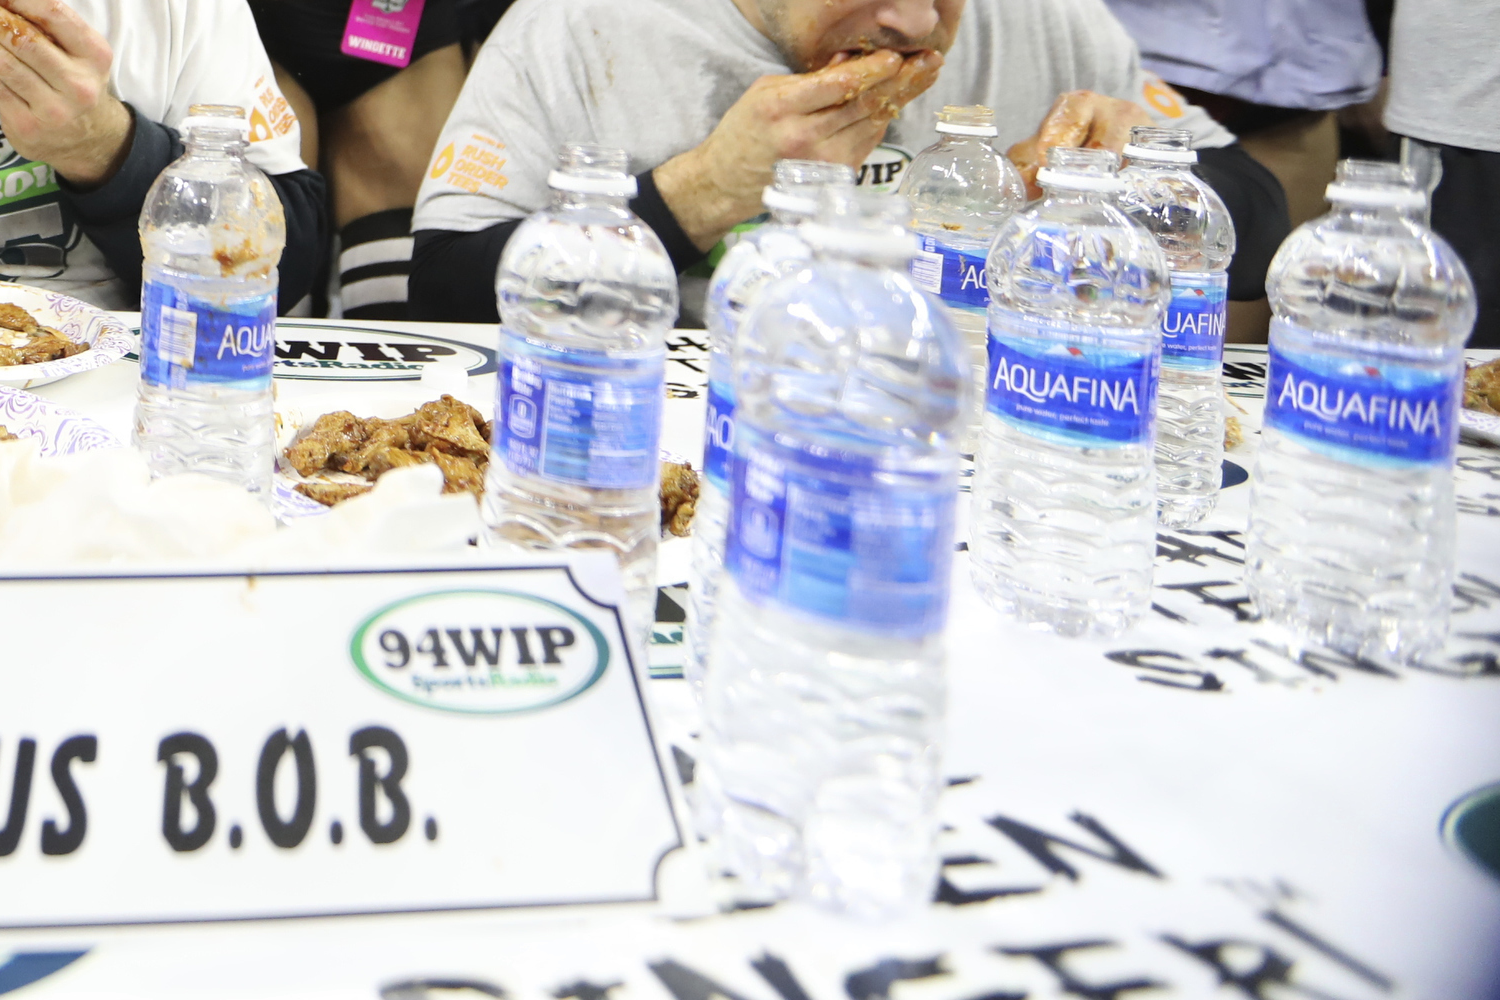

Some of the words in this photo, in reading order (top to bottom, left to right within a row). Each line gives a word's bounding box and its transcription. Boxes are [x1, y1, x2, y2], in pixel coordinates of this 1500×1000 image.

[348, 34, 407, 60] WINGETTE
[454, 158, 509, 190] ORDER
[461, 144, 507, 171] RUSH
[216, 323, 274, 360] AQUA
[1161, 310, 1226, 338] UAFIN
[993, 356, 1140, 416] AQUAFINA
[1278, 372, 1440, 438] AQUAFINA
[379, 625, 576, 668] 94WIP
[157, 725, 439, 852] B.O.B.
